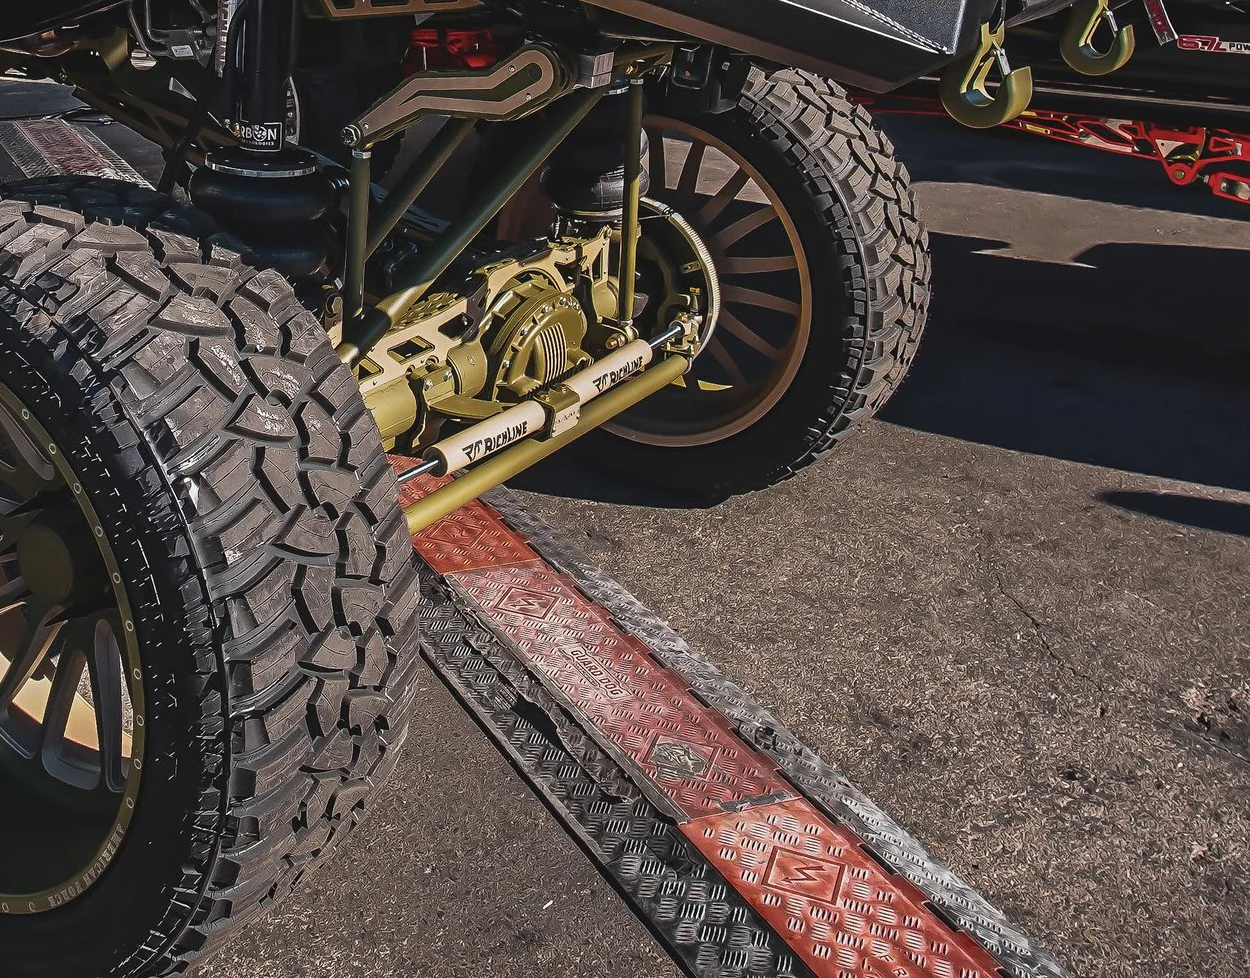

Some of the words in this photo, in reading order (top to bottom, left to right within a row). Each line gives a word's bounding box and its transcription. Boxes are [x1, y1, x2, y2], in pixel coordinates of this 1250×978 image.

[609, 356, 643, 386] RICHLINE
[483, 420, 528, 455] RICHLINE
[570, 648, 604, 678] GUARD
[599, 677, 624, 698] DOG
